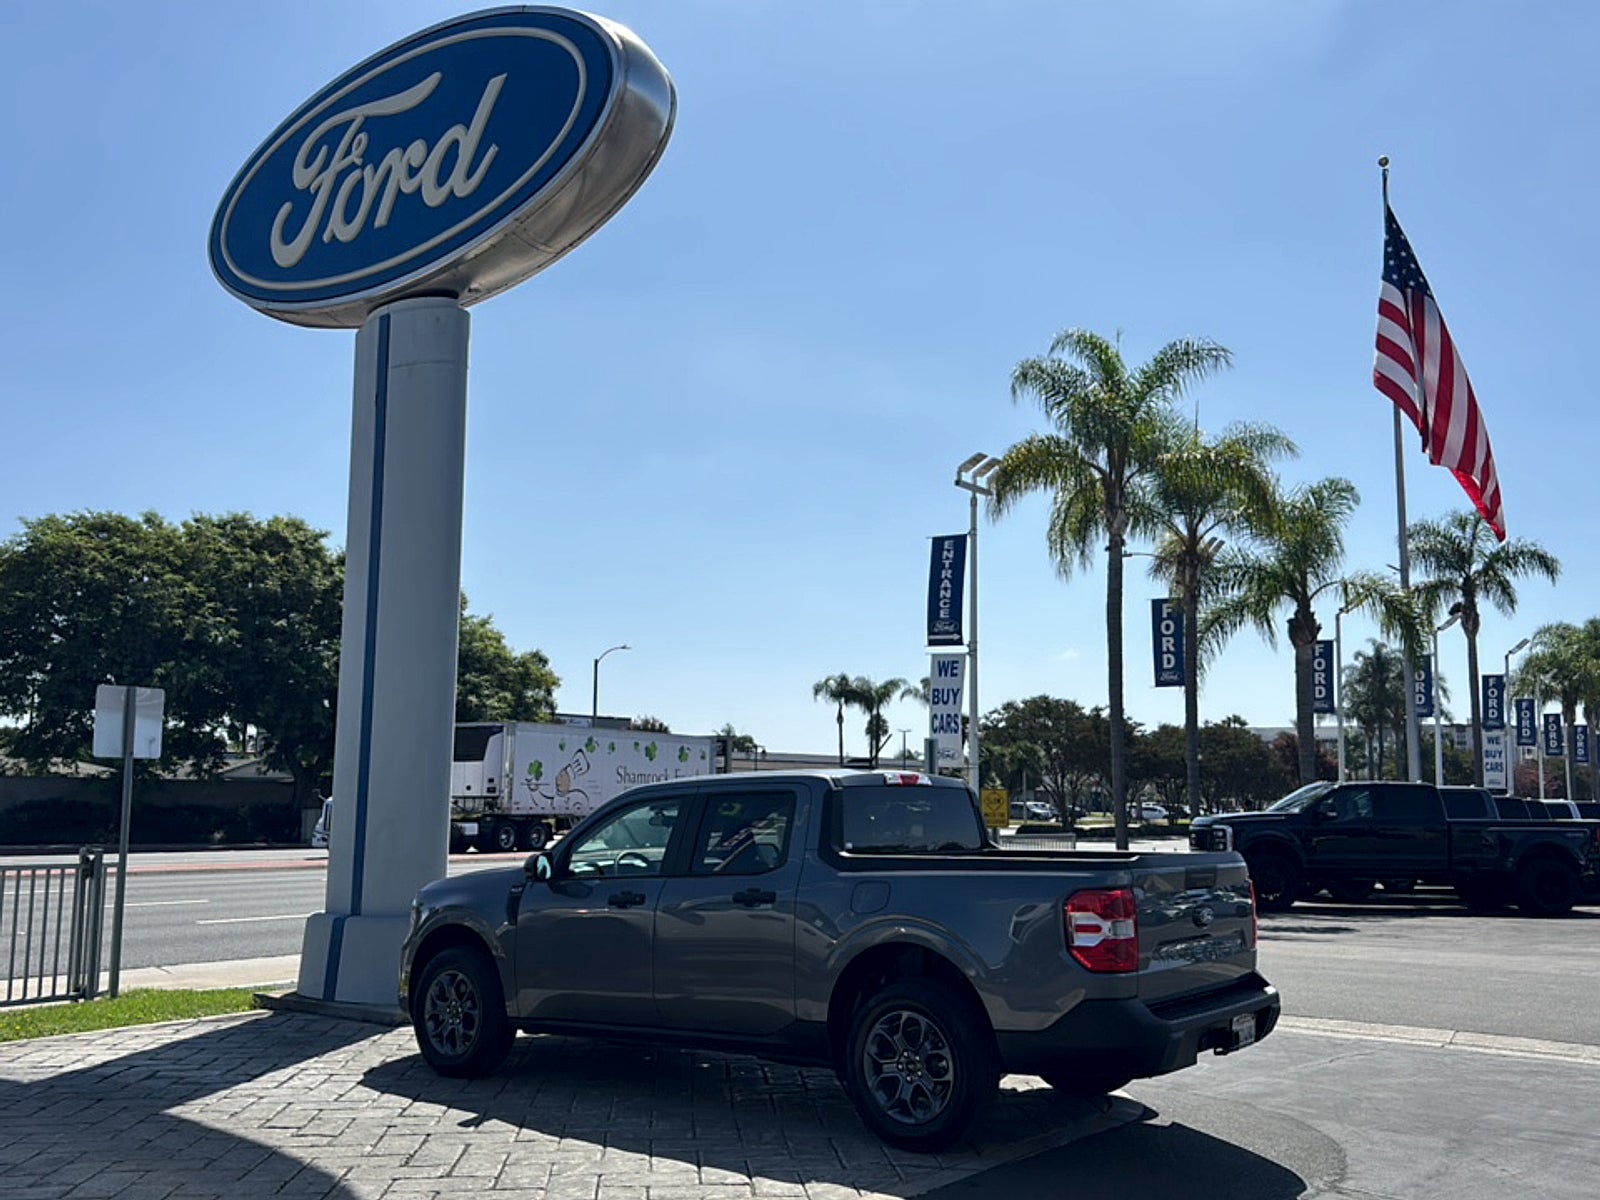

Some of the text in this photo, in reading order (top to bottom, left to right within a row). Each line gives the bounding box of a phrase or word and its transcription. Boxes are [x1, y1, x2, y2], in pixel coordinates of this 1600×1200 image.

[270, 71, 508, 268] Ford
[939, 540, 954, 618] ENTRANCE
[1160, 603, 1176, 669] FORD
[937, 660, 959, 677] WE
[1313, 644, 1326, 698] FORD
[1415, 660, 1425, 705] ORD
[931, 687, 960, 705] BUY
[1487, 677, 1498, 718] FORD
[931, 713, 960, 734] CARS
[1521, 702, 1531, 736] FORD
